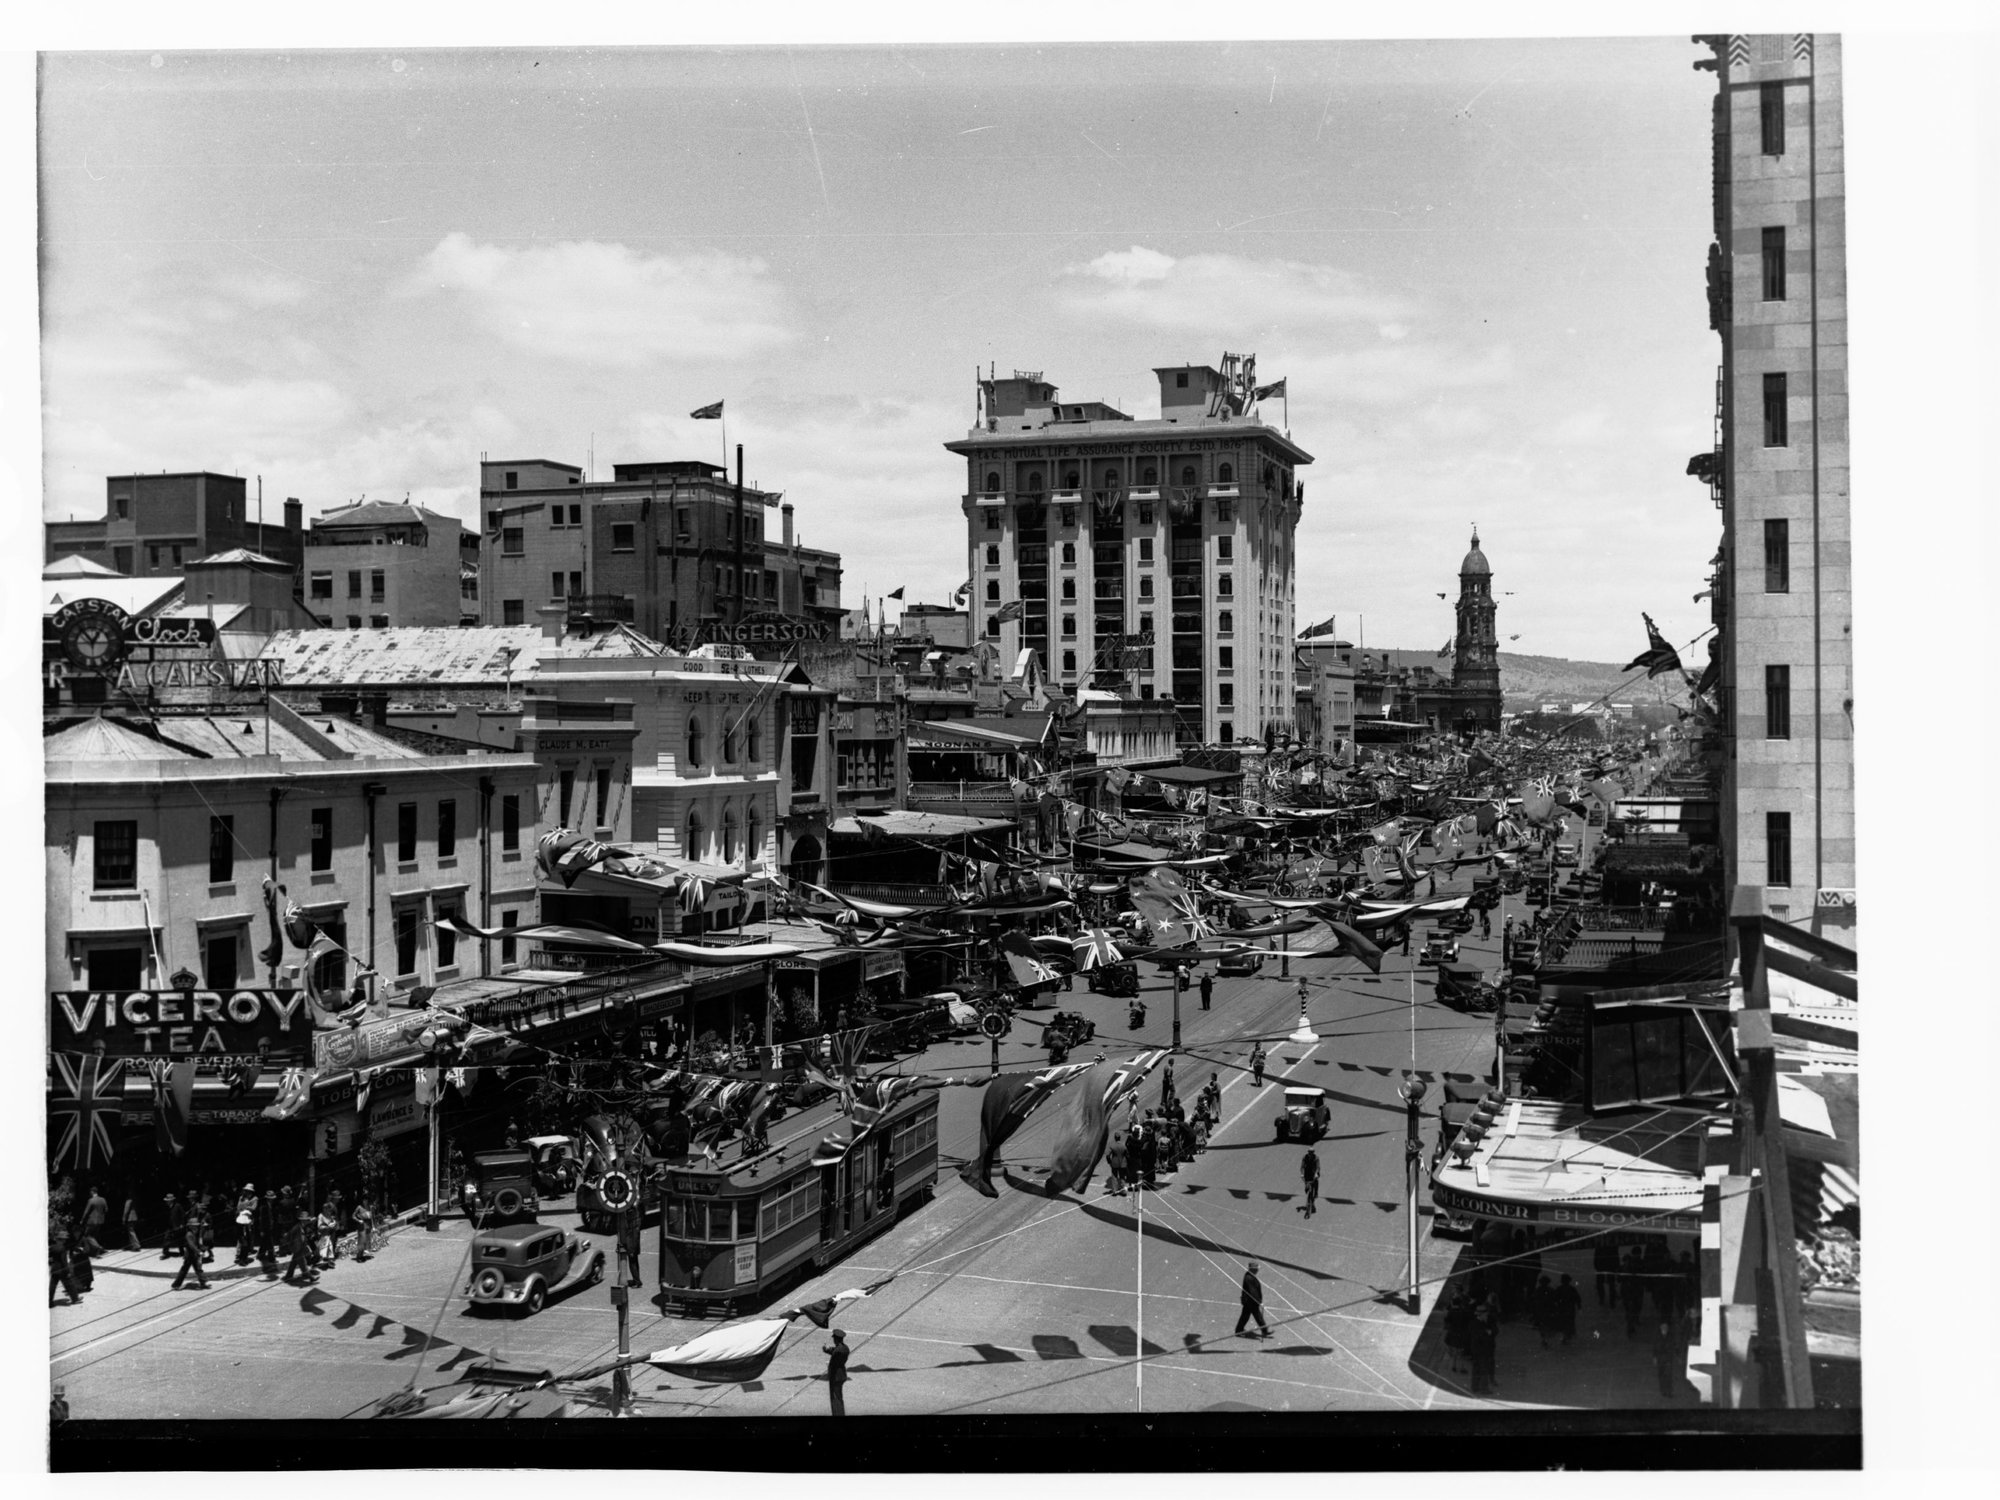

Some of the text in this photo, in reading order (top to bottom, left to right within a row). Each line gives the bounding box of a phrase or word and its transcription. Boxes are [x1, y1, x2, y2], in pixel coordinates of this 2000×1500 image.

[1004, 447, 1043, 458] MUTUAL
[1048, 445, 1069, 457] LIFE
[1076, 441, 1134, 456] ASSURANCE
[52, 599, 132, 631] CAPSTAN
[134, 617, 202, 644] Clock
[712, 623, 821, 642] INGERSON
[147, 659, 284, 688] CAPSTAN
[683, 662, 705, 672] GOOD
[728, 692, 740, 704] THE
[539, 740, 571, 750] CLAUDE
[55, 990, 305, 1035] VICEROY
[133, 1025, 227, 1053] TEA
[125, 1055, 264, 1069] ROYAL BEVERAGE
[319, 1067, 415, 1106] TOBACONI
[677, 1180, 716, 1191] UNLEY
[1460, 1196, 1529, 1219] CORNER
